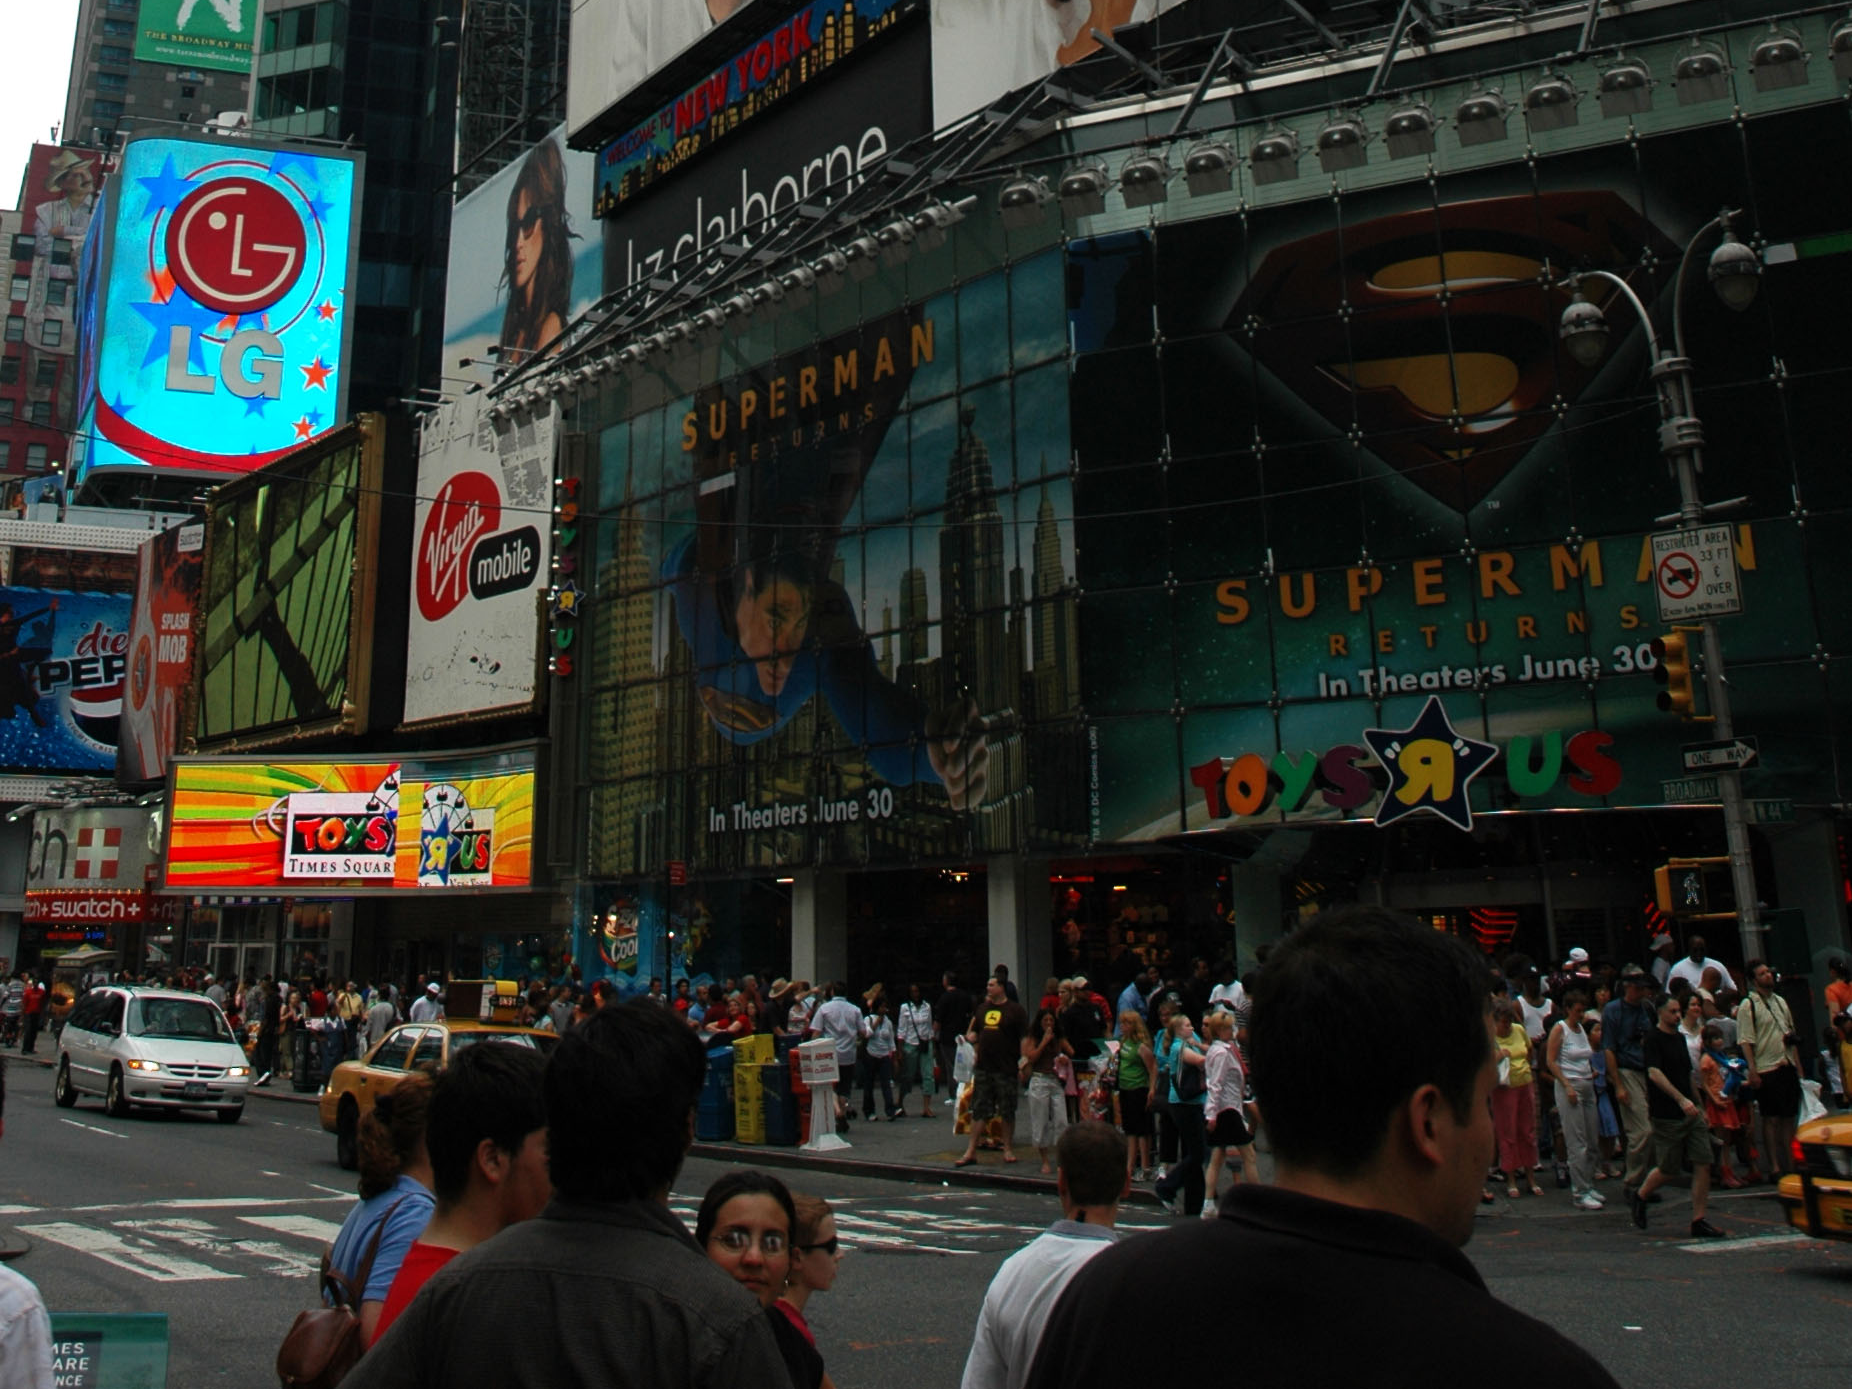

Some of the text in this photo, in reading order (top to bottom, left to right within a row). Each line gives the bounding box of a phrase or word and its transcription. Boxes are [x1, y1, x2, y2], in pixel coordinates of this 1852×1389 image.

[145, 31, 168, 41] THE
[171, 34, 231, 48] BROADWAY
[605, 9, 813, 166] WELCOME TO NEW YORK
[165, 324, 285, 401] LG
[682, 318, 935, 452] SUPERMAN
[425, 483, 485, 602] Virgin
[1705, 531, 1729, 544] AREA
[477, 538, 532, 586] mobile
[1700, 547, 1729, 562] 33 FT
[1706, 582, 1733, 596] OVER
[161, 612, 190, 631] SPLASH
[1329, 605, 1640, 657] RETURNS
[158, 635, 188, 663] MOB
[1318, 642, 1658, 698] In Theaters June 30
[1691, 747, 1749, 765] ONE WAY
[1190, 744, 1372, 820] TOYS
[1506, 728, 1623, 798] US
[1663, 778, 1717, 802] BROADWAY
[709, 787, 894, 833] In Theaters June 30
[295, 815, 389, 852] TOYS
[288, 859, 338, 873] TIMES
[460, 834, 490, 870] US
[51, 898, 126, 918] swatch
[611, 938, 639, 963] Cool
